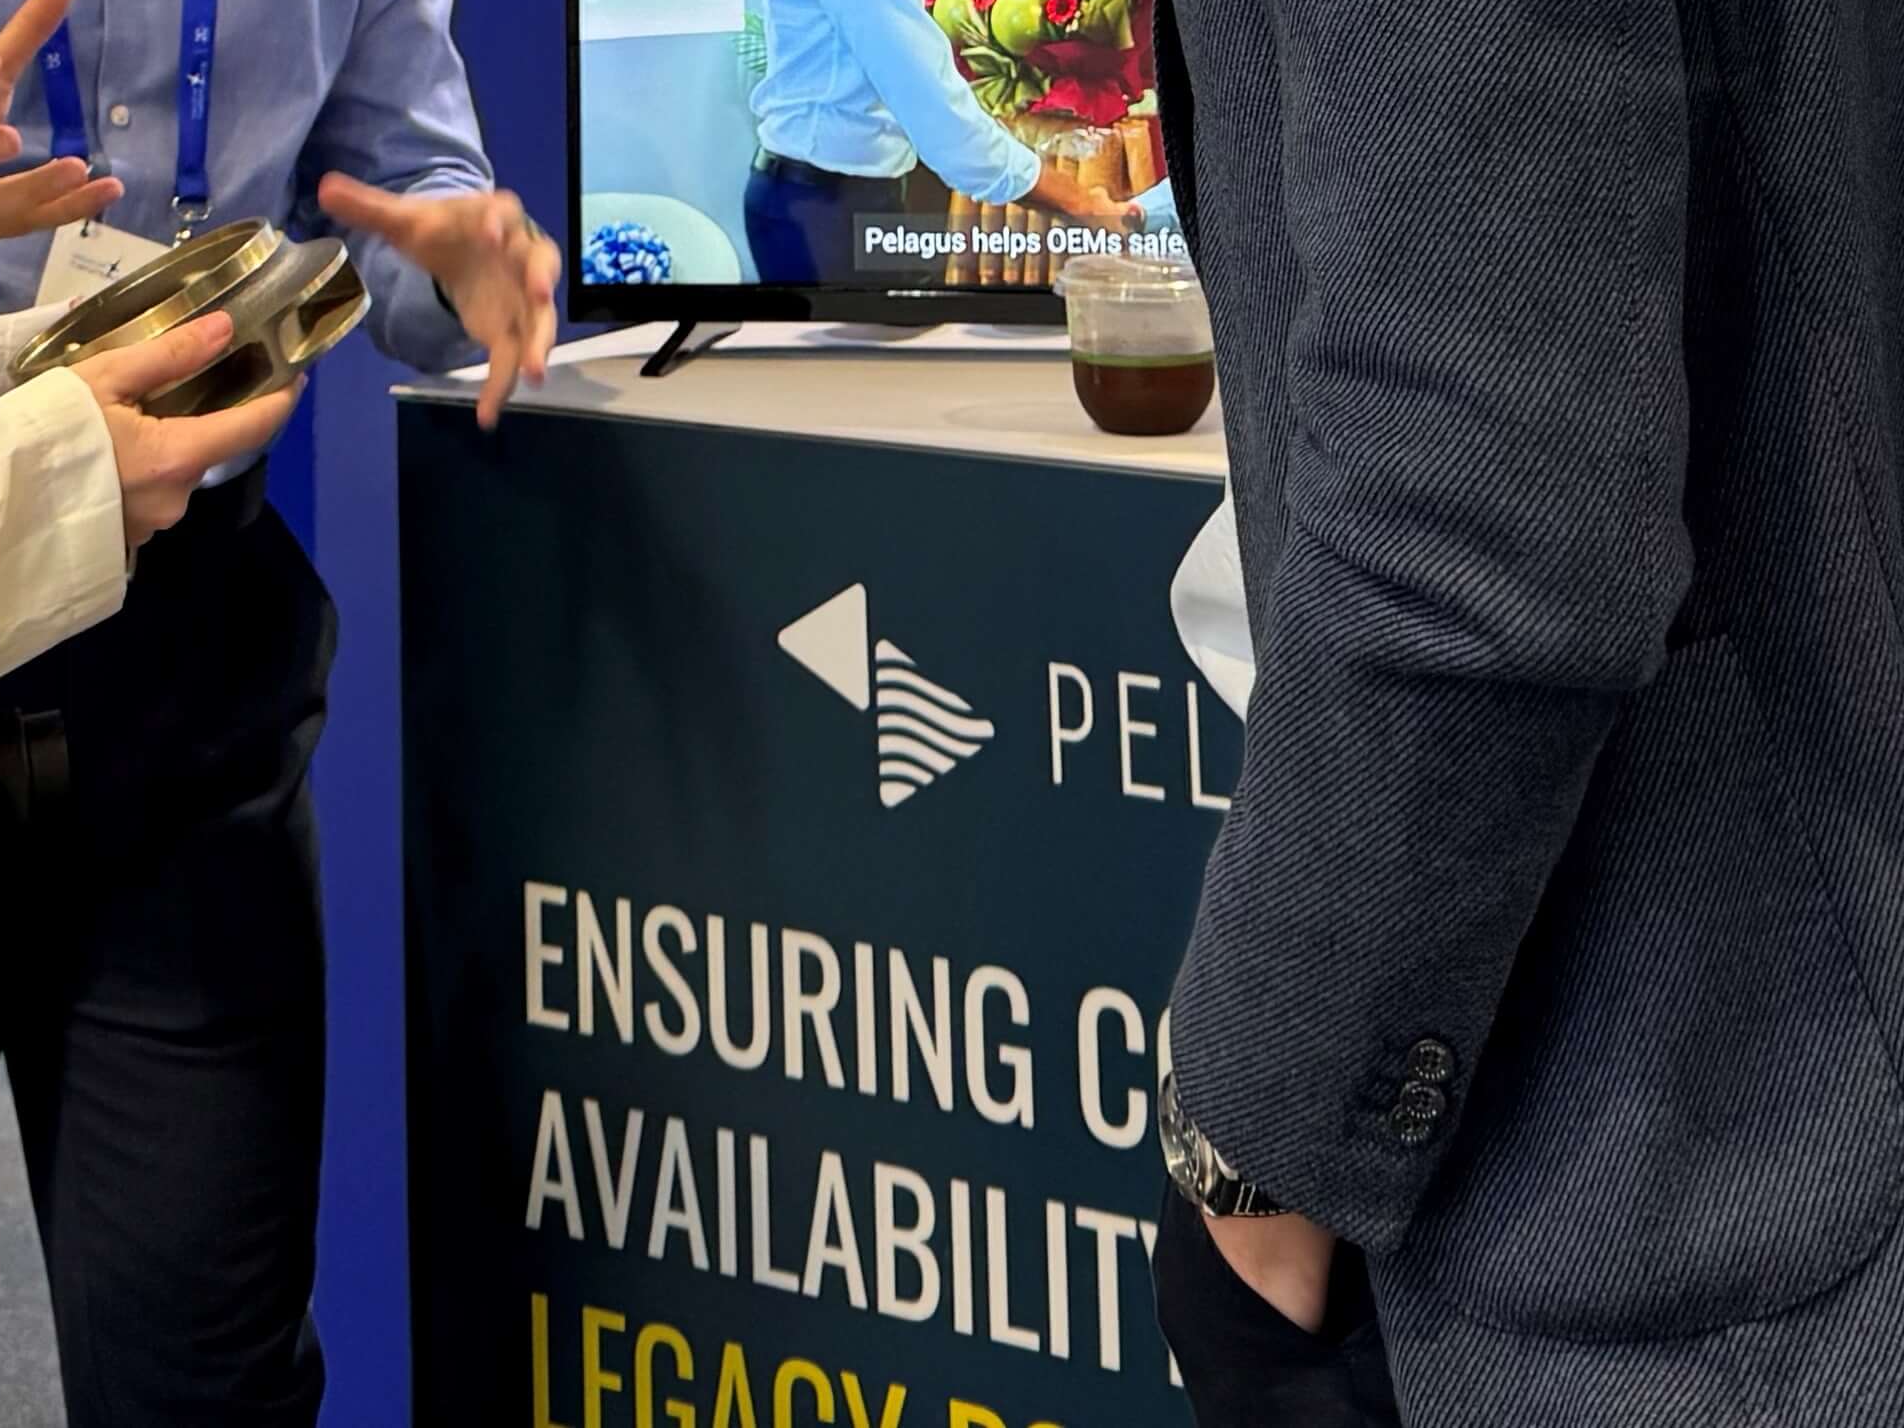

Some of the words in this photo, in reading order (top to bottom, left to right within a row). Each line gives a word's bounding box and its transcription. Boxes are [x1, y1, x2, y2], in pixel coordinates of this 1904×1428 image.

[865, 226, 967, 259] Pelagus
[972, 226, 1041, 259] helps
[1047, 227, 1122, 255] OEMs
[1047, 660, 1233, 811] PEL
[524, 879, 1035, 1130] ENSURING
